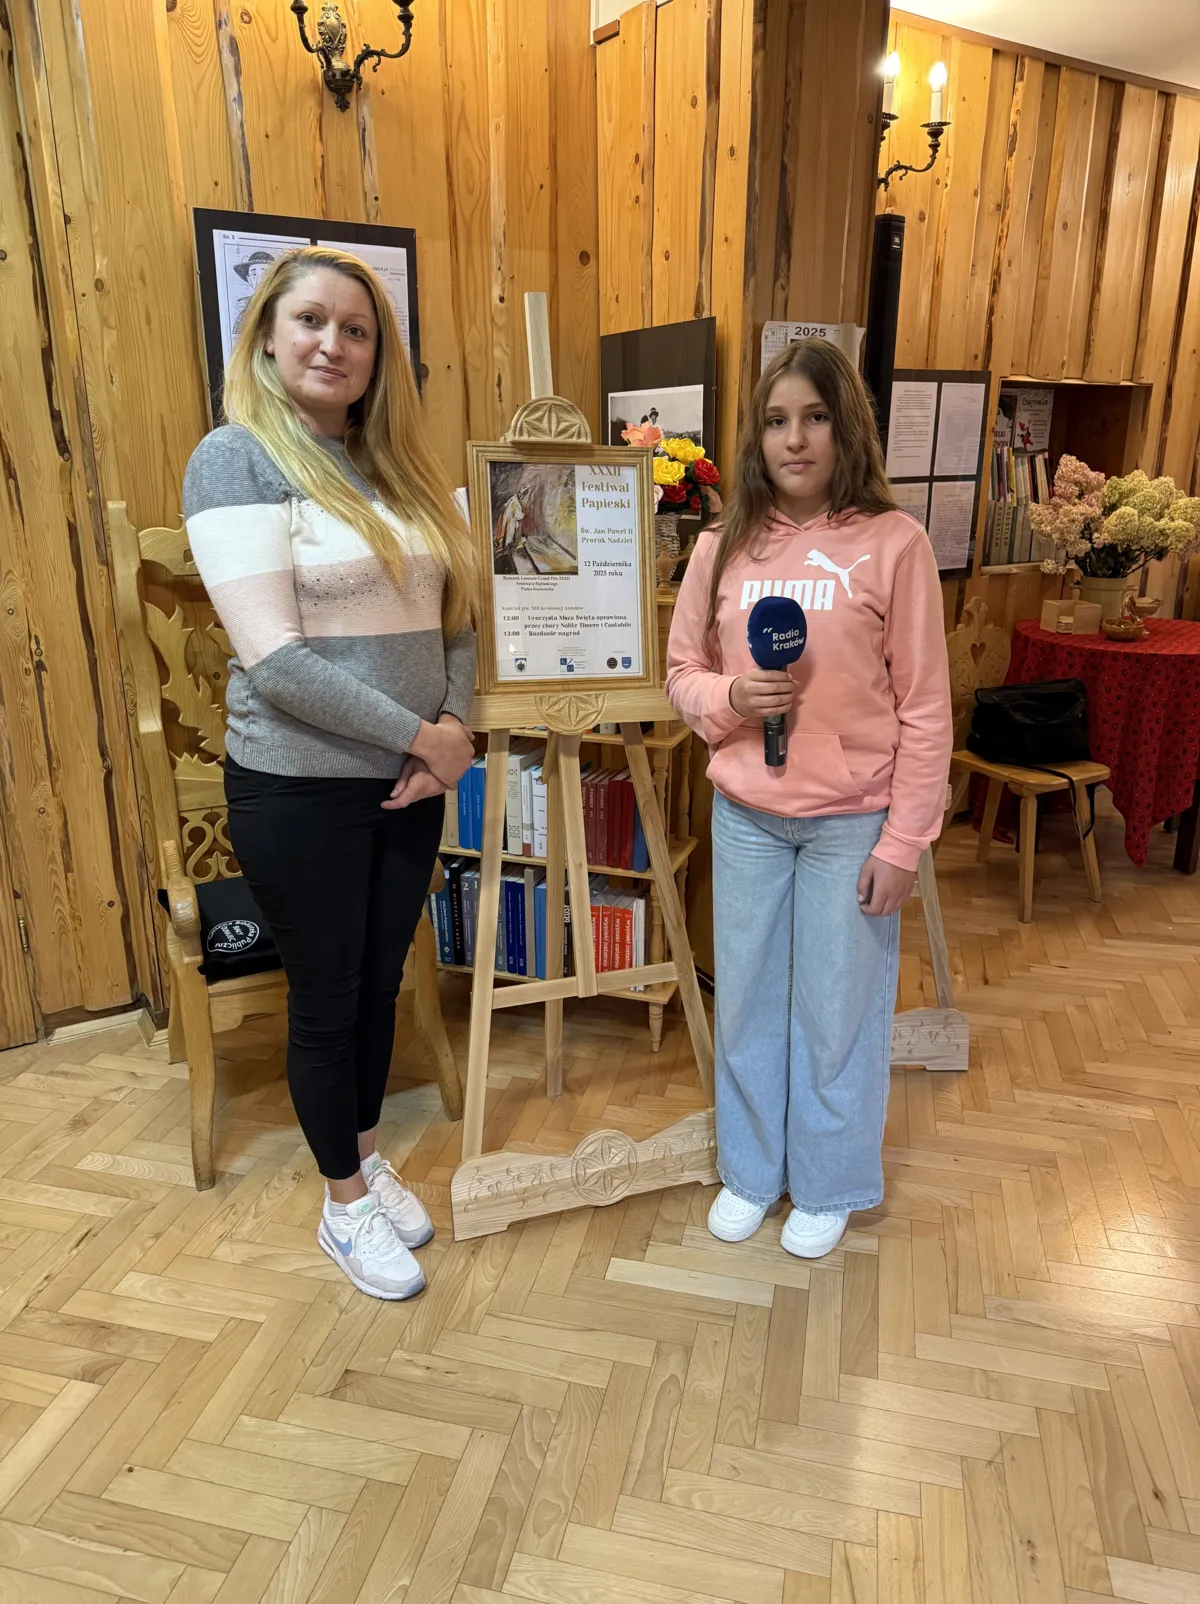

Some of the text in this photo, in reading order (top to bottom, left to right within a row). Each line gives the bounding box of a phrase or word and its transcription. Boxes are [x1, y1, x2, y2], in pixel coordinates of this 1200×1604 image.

[794, 326, 827, 337] 2025
[589, 465, 621, 477] XXXII
[581, 481, 630, 493] Festiwal
[581, 498, 631, 510] Papieski
[580, 526, 592, 535] Św.
[1004, 506, 1012, 547] KOESTLER
[739, 579, 836, 610] PUMA
[772, 628, 800, 642] Radio
[772, 637, 805, 652] Kraków
[463, 882, 470, 891] 2
